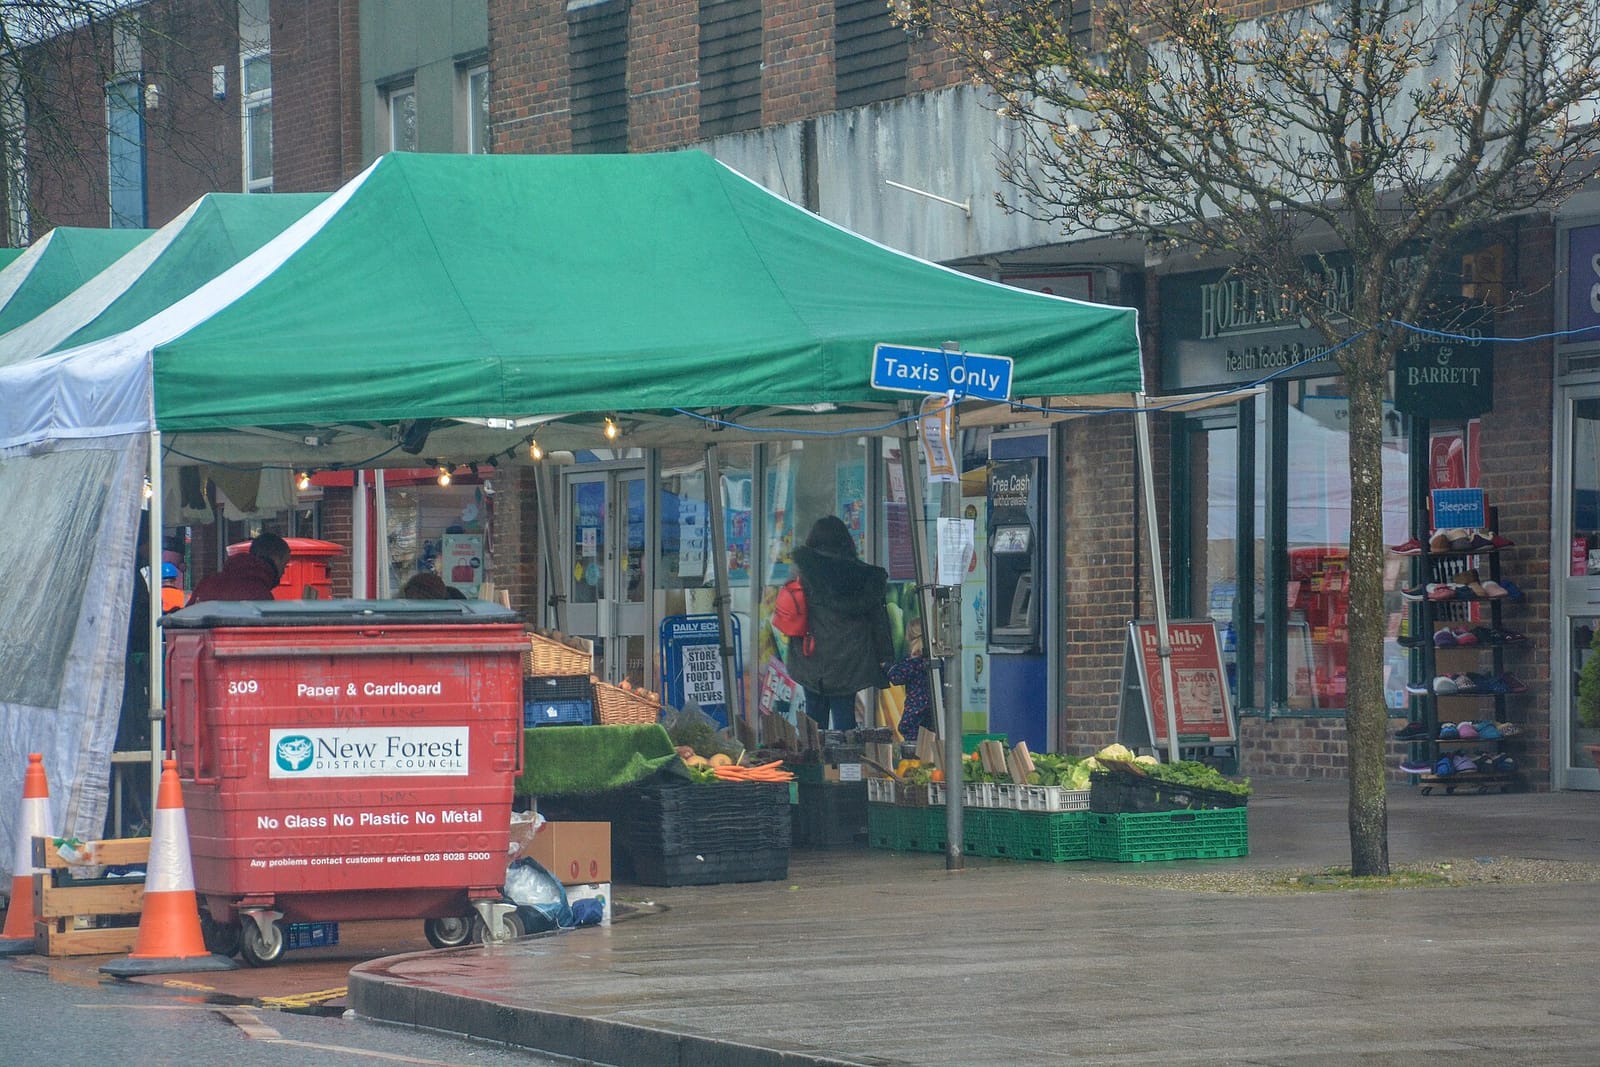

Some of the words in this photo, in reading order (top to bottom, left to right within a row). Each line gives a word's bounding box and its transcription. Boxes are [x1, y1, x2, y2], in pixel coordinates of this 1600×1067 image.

[1225, 347, 1256, 372] health
[1259, 346, 1287, 367] foods
[1291, 344, 1299, 363] &
[1437, 346, 1453, 365] &
[884, 358, 940, 382] Taxis
[950, 365, 1000, 391] Only
[1408, 366, 1481, 386] BARRETT
[991, 476, 1009, 491] Free
[1009, 473, 1031, 492] Cash
[993, 494, 1028, 507] withdrawals
[1438, 501, 1478, 514] Sleepers
[672, 623, 699, 632] DAILY
[700, 622, 720, 631] ECH
[1144, 629, 1204, 649] halthy
[688, 650, 717, 662] STORE
[686, 672, 709, 683] FOOD
[710, 670, 721, 680] TO
[227, 680, 258, 695] 309
[297, 683, 341, 698] Paper
[346, 682, 357, 696] &
[363, 681, 441, 696] Cardboard
[694, 681, 715, 692] BEAT
[688, 690, 723, 702] THIEVES
[316, 736, 377, 760] New
[385, 735, 463, 759] Forest
[316, 759, 386, 769] DISTRICT
[395, 759, 462, 769] COUNCIL
[257, 816, 279, 829] No
[284, 814, 327, 829] Glass
[332, 813, 354, 827] No
[360, 811, 410, 826] Plastic
[415, 810, 436, 825] No
[441, 808, 483, 824] Metal
[250, 858, 267, 868] Any
[269, 857, 308, 868] problems
[310, 856, 343, 866] contact
[345, 854, 384, 864] customer
[386, 853, 421, 863] services
[423, 853, 440, 862] 023
[442, 852, 465, 861] 8028
[467, 852, 491, 861] 5000
